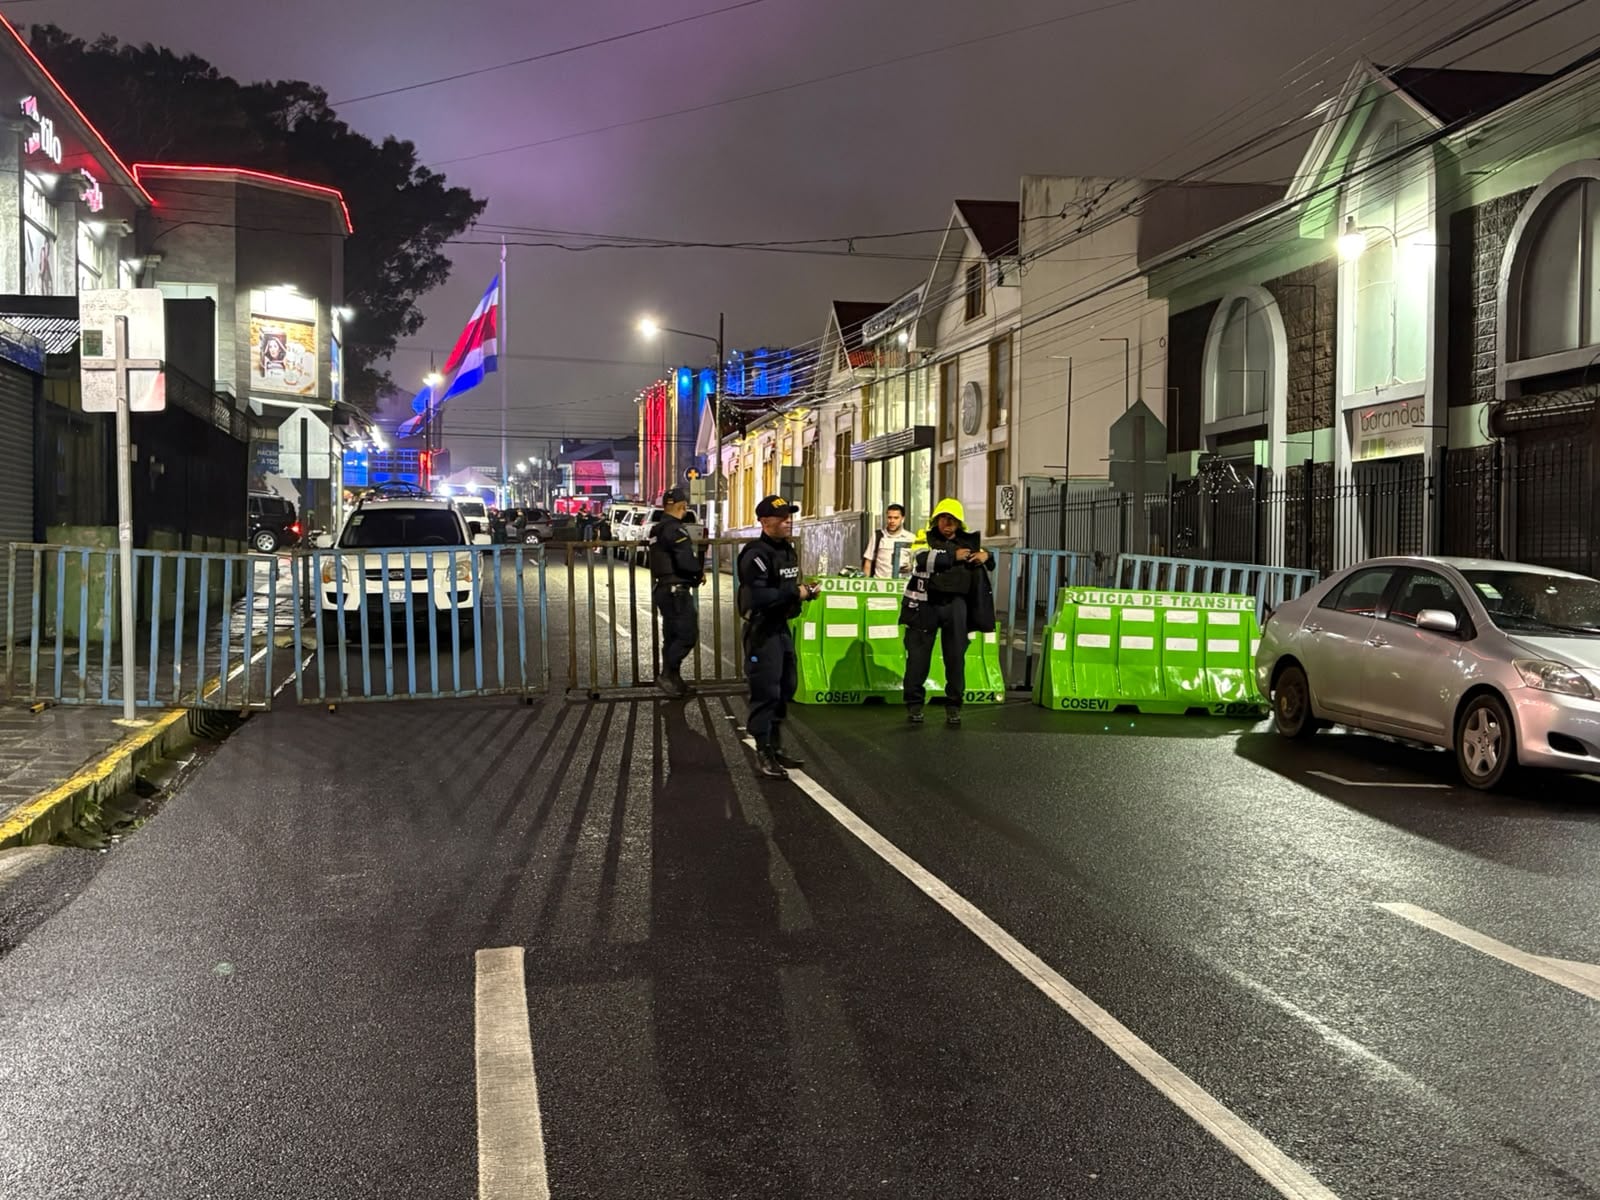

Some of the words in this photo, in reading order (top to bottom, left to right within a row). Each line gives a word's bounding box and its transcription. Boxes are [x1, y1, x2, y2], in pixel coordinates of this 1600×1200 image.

[1360, 402, 1425, 432] barandas
[819, 579, 879, 592] OLICIA
[886, 581, 905, 593] DE
[1065, 591, 1135, 606] POLICIA
[1142, 594, 1164, 606] DE
[1171, 595, 1256, 609] TRANSITO
[815, 691, 861, 703] COSEVI
[1060, 697, 1109, 711] COSEVI
